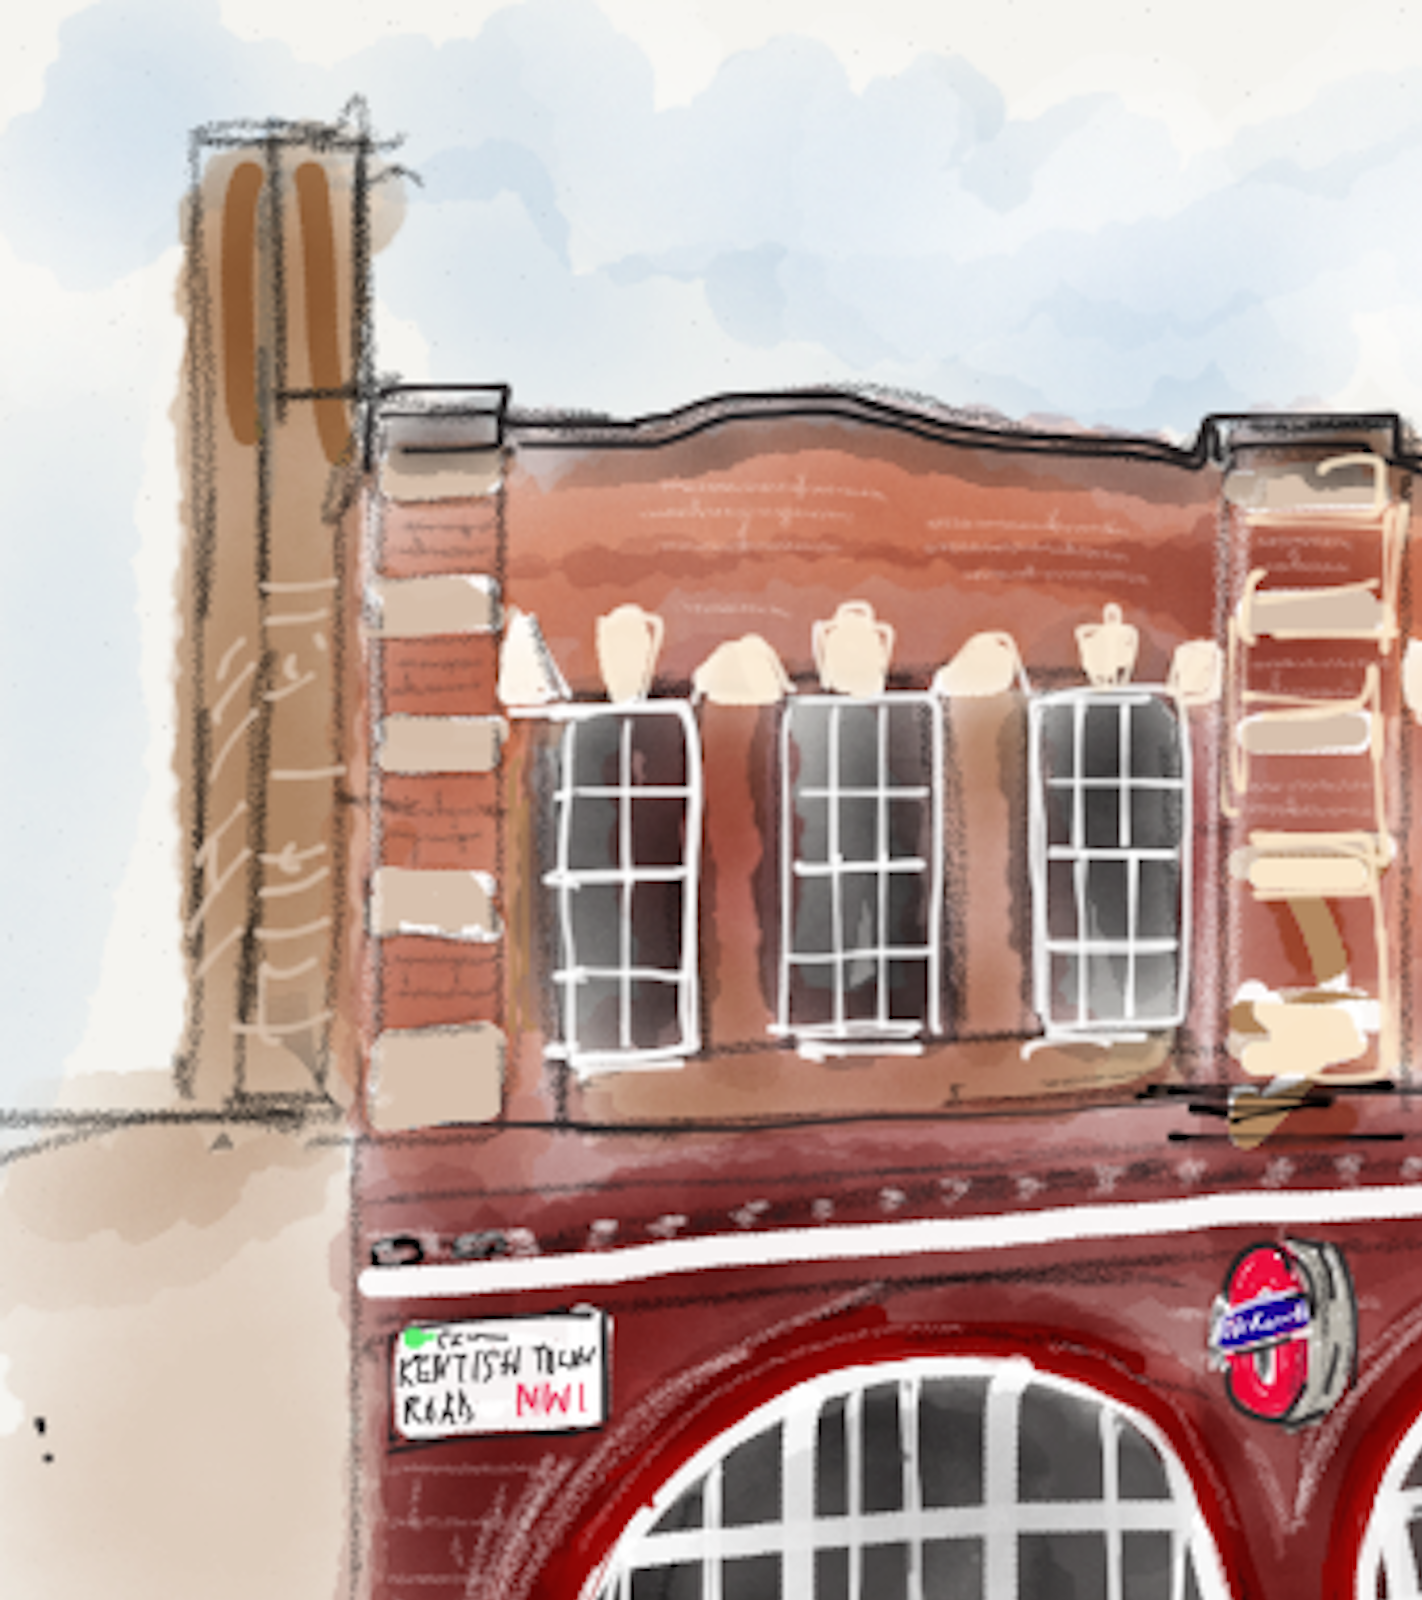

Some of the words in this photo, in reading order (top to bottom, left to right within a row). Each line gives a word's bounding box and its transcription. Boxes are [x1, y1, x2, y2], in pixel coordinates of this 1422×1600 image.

[399, 1346, 522, 1387] KENTISH
[404, 1388, 475, 1425] ROAD
[515, 1382, 587, 1418] NW1
